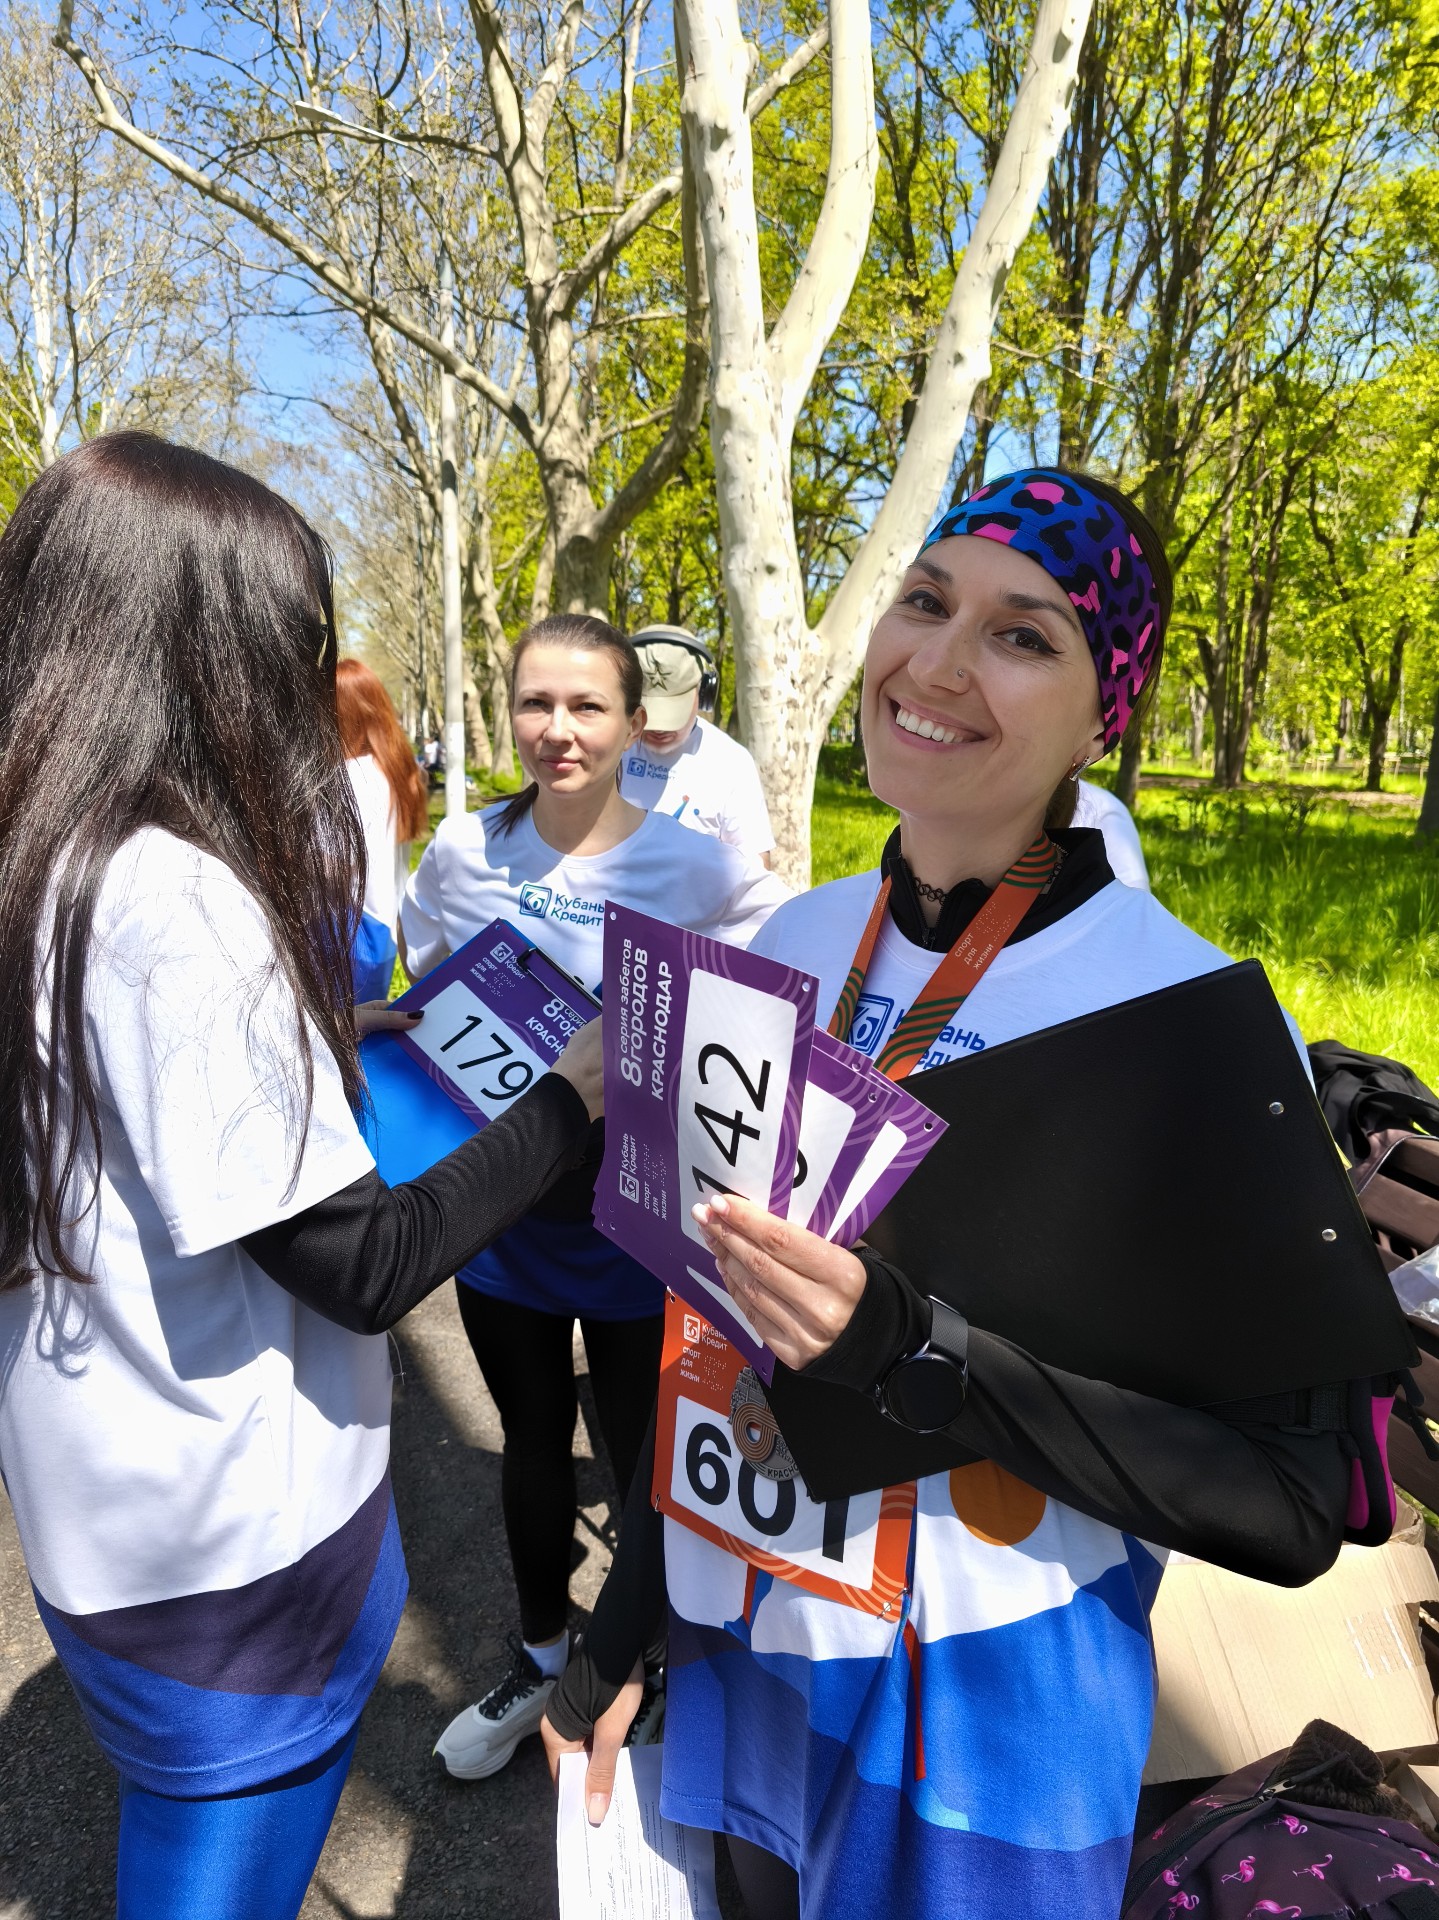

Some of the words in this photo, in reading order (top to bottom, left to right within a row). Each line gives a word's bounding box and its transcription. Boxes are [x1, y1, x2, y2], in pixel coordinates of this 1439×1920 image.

[554, 893, 605, 913] Кубань
[550, 907, 603, 926] Кредит
[954, 932, 974, 958] спорт
[482, 957, 498, 971] спорт
[963, 947, 978, 966] для
[972, 943, 994, 970] жизни
[474, 962, 486, 973] для
[504, 959, 526, 980] Кредит
[619, 938, 632, 1006] забегов
[620, 1008, 629, 1054] серия
[651, 961, 673, 1101] КРАСНОДАР
[440, 1015, 534, 1101] 179
[691, 1043, 771, 1201] 142
[621, 1133, 631, 1170] Кубань
[628, 1135, 637, 1175] Кредит
[652, 1196, 660, 1217] для
[682, 1346, 701, 1359] спорт
[701, 1334, 728, 1351] Кредит
[681, 1358, 693, 1368] для
[680, 1369, 700, 1383] жизни
